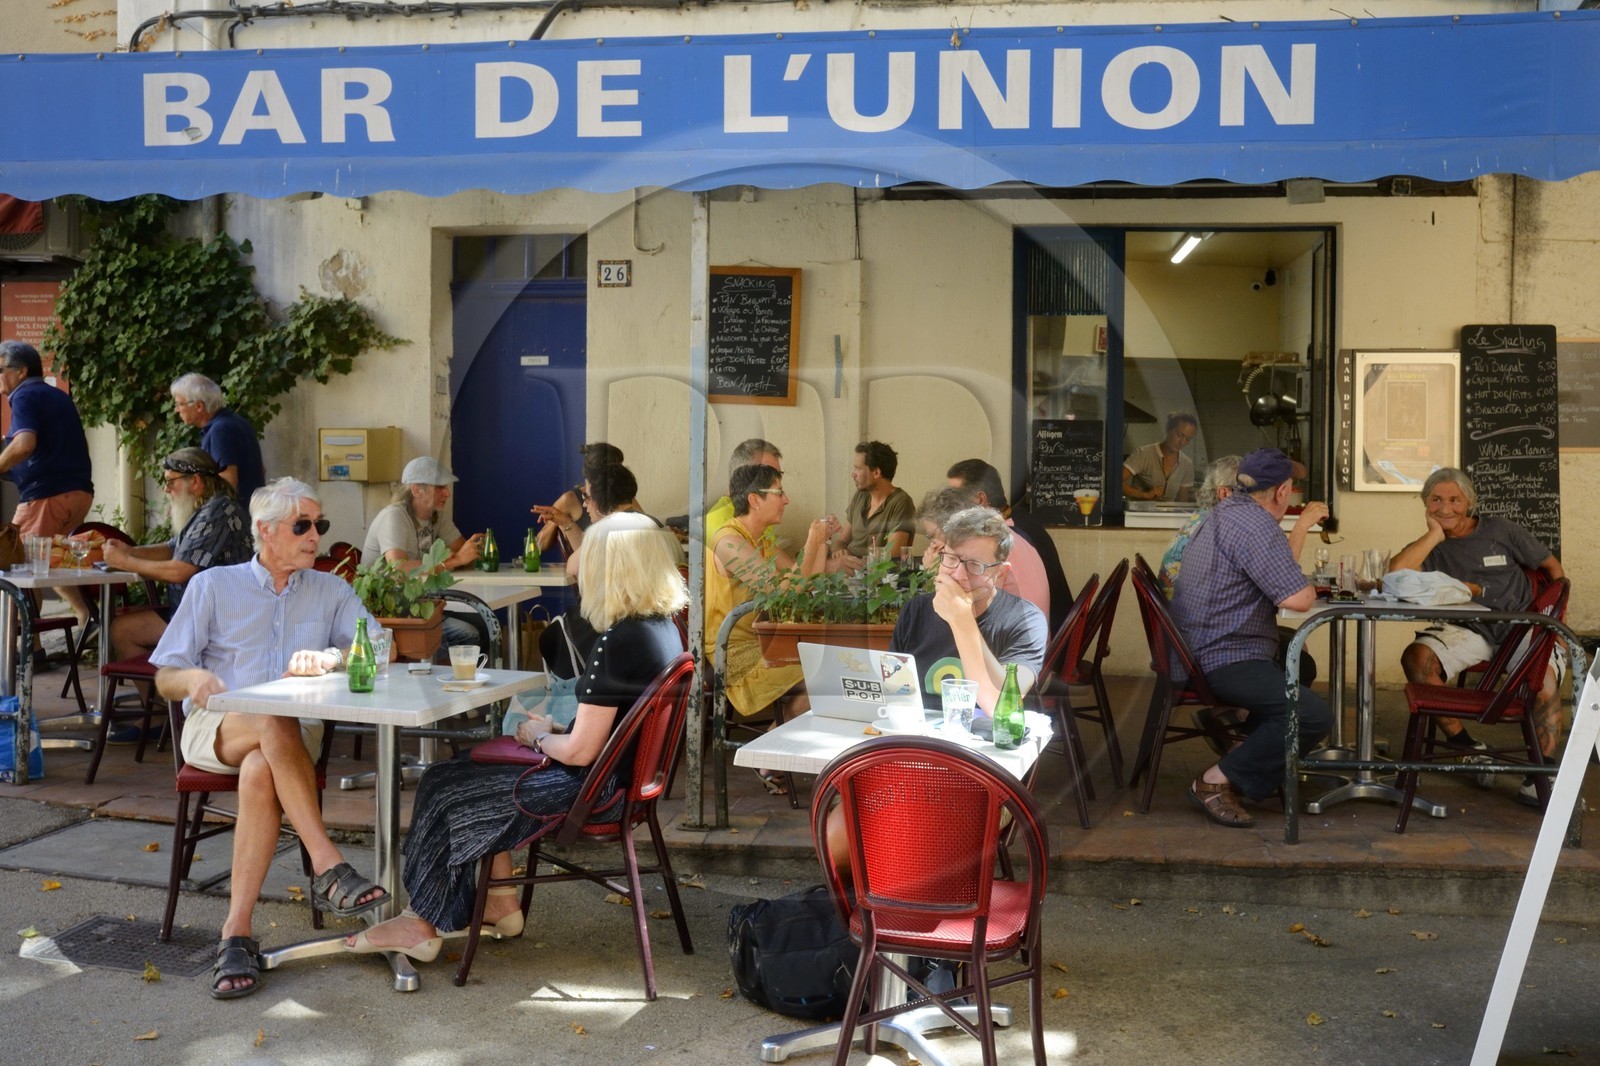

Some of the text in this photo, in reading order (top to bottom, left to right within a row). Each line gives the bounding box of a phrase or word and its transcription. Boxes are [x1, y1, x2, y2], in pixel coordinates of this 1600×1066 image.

[143, 43, 1317, 147] BAR DE L'UNION
[604, 266, 625, 281] 26
[1343, 357, 1351, 383] BAR
[1343, 394, 1350, 411] DE
